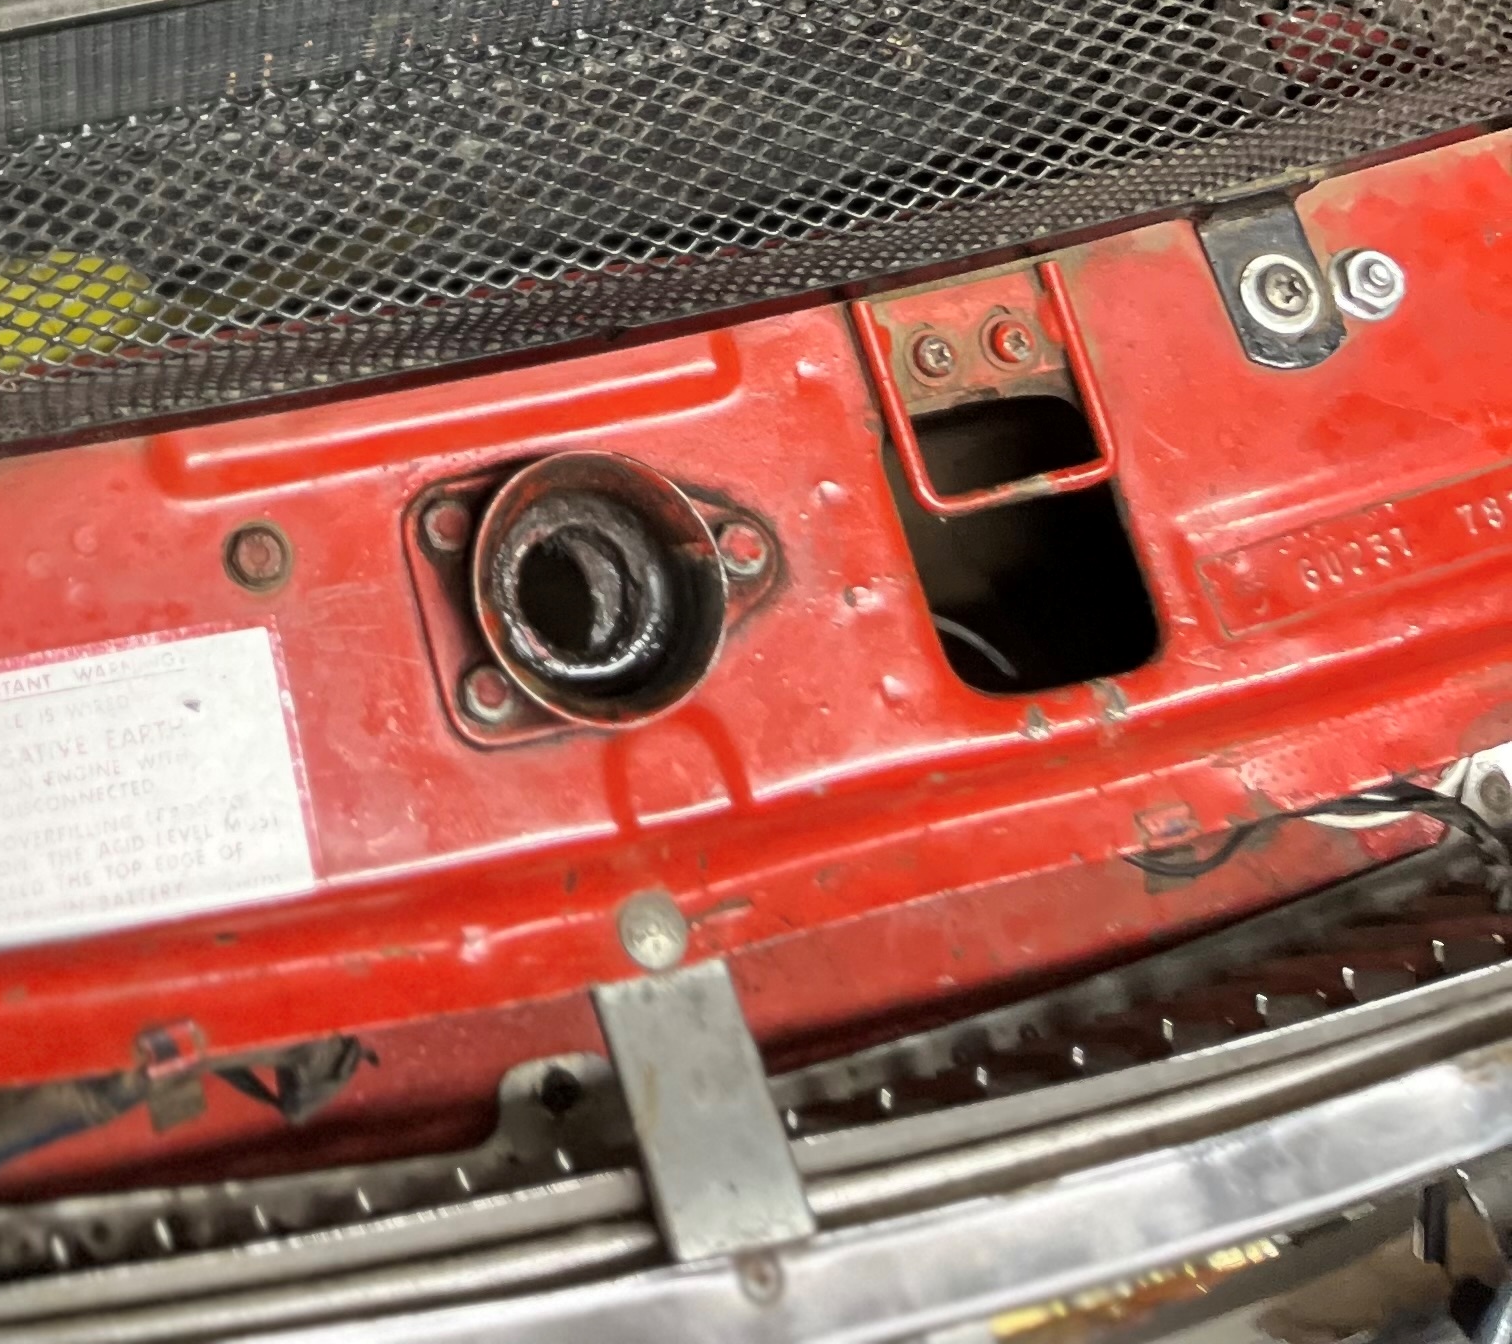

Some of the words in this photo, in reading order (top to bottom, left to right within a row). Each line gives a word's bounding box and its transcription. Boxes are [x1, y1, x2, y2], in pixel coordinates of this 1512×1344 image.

[72, 648, 186, 683] WARNNG.
[37, 705, 55, 724] IS
[41, 757, 122, 788] ENGINE
[0, 777, 155, 820] DISCONNECTED
[1, 812, 136, 852] OVERFILLING
[46, 844, 84, 869] THE
[96, 833, 146, 859] ACID
[155, 821, 215, 848] LEVEL
[55, 868, 94, 892] THE
[103, 858, 144, 883] TOP
[153, 847, 207, 874] EDGE
